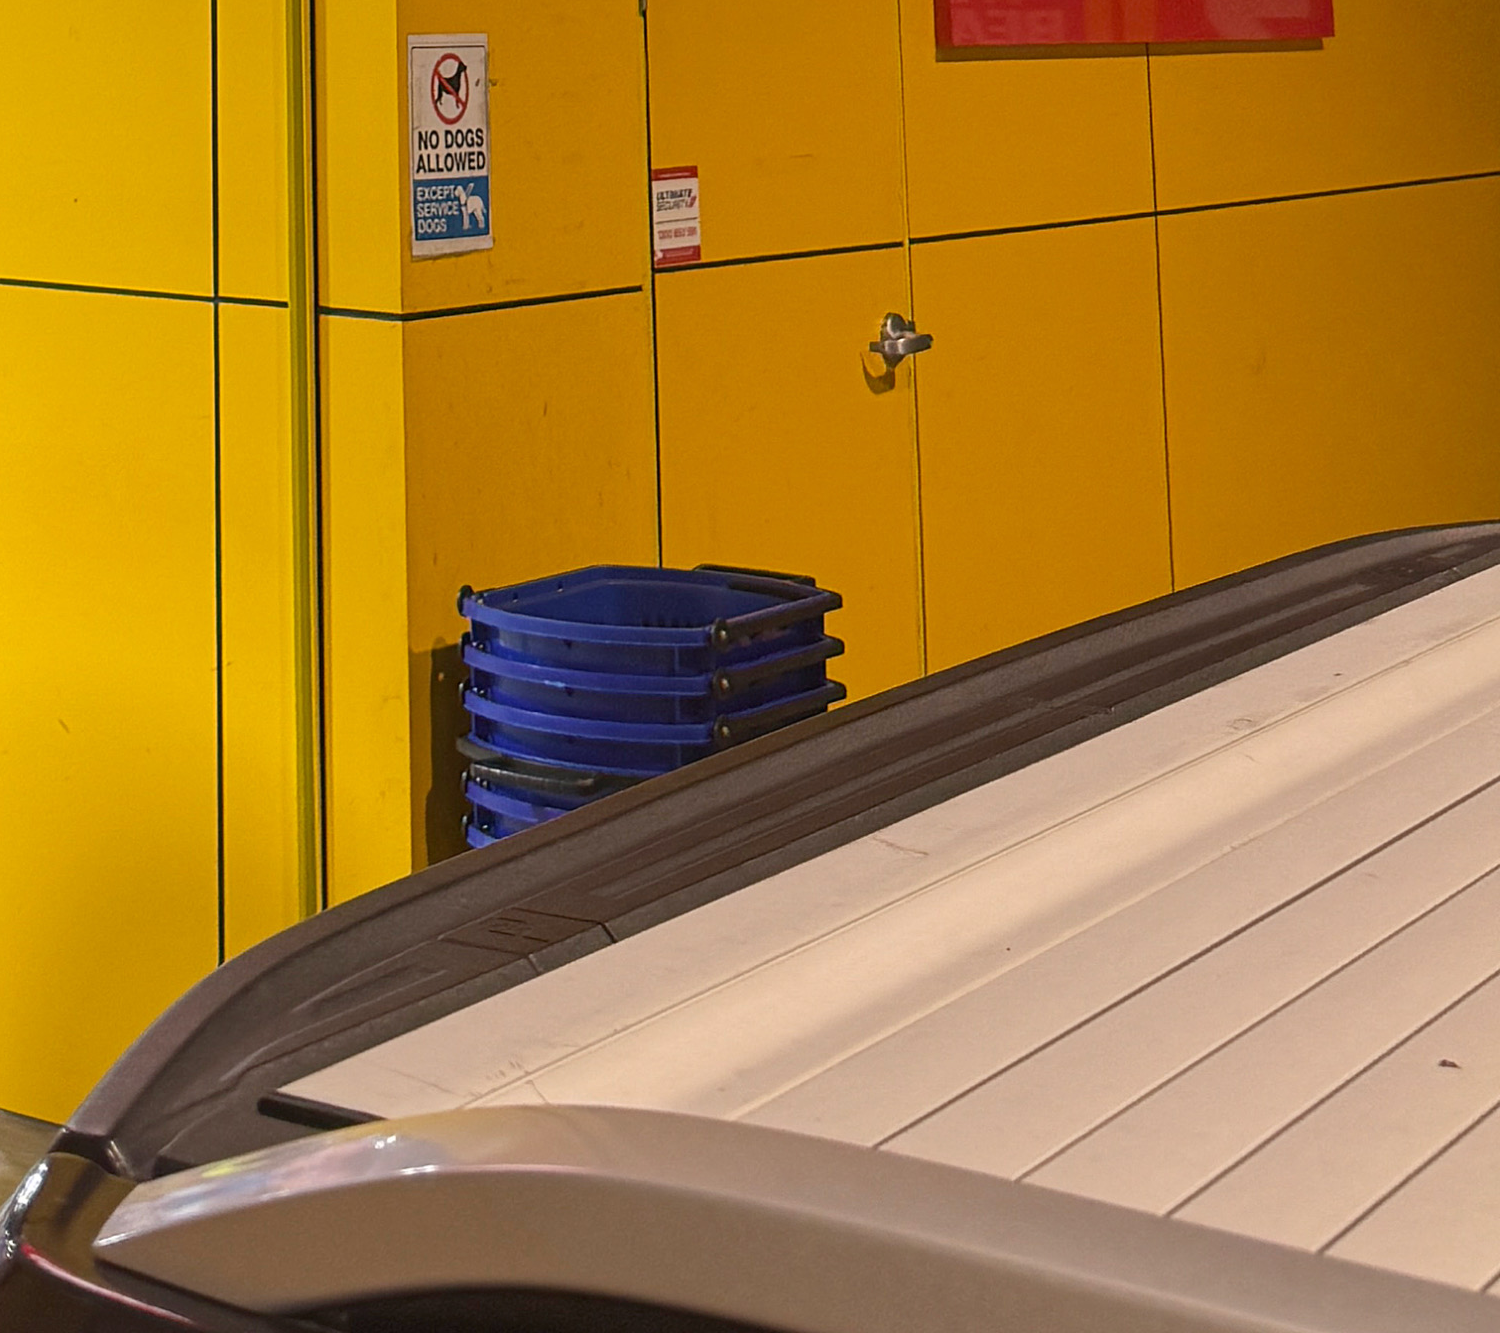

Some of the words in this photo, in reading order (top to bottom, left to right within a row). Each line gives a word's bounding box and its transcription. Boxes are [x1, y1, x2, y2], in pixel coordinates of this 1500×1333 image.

[418, 130, 440, 151] NO
[444, 127, 484, 148] DOGS
[416, 150, 486, 174] ALLOWED
[416, 185, 455, 201] EXCEPT
[417, 201, 459, 217] SERVICE
[417, 218, 447, 233] DOGS
